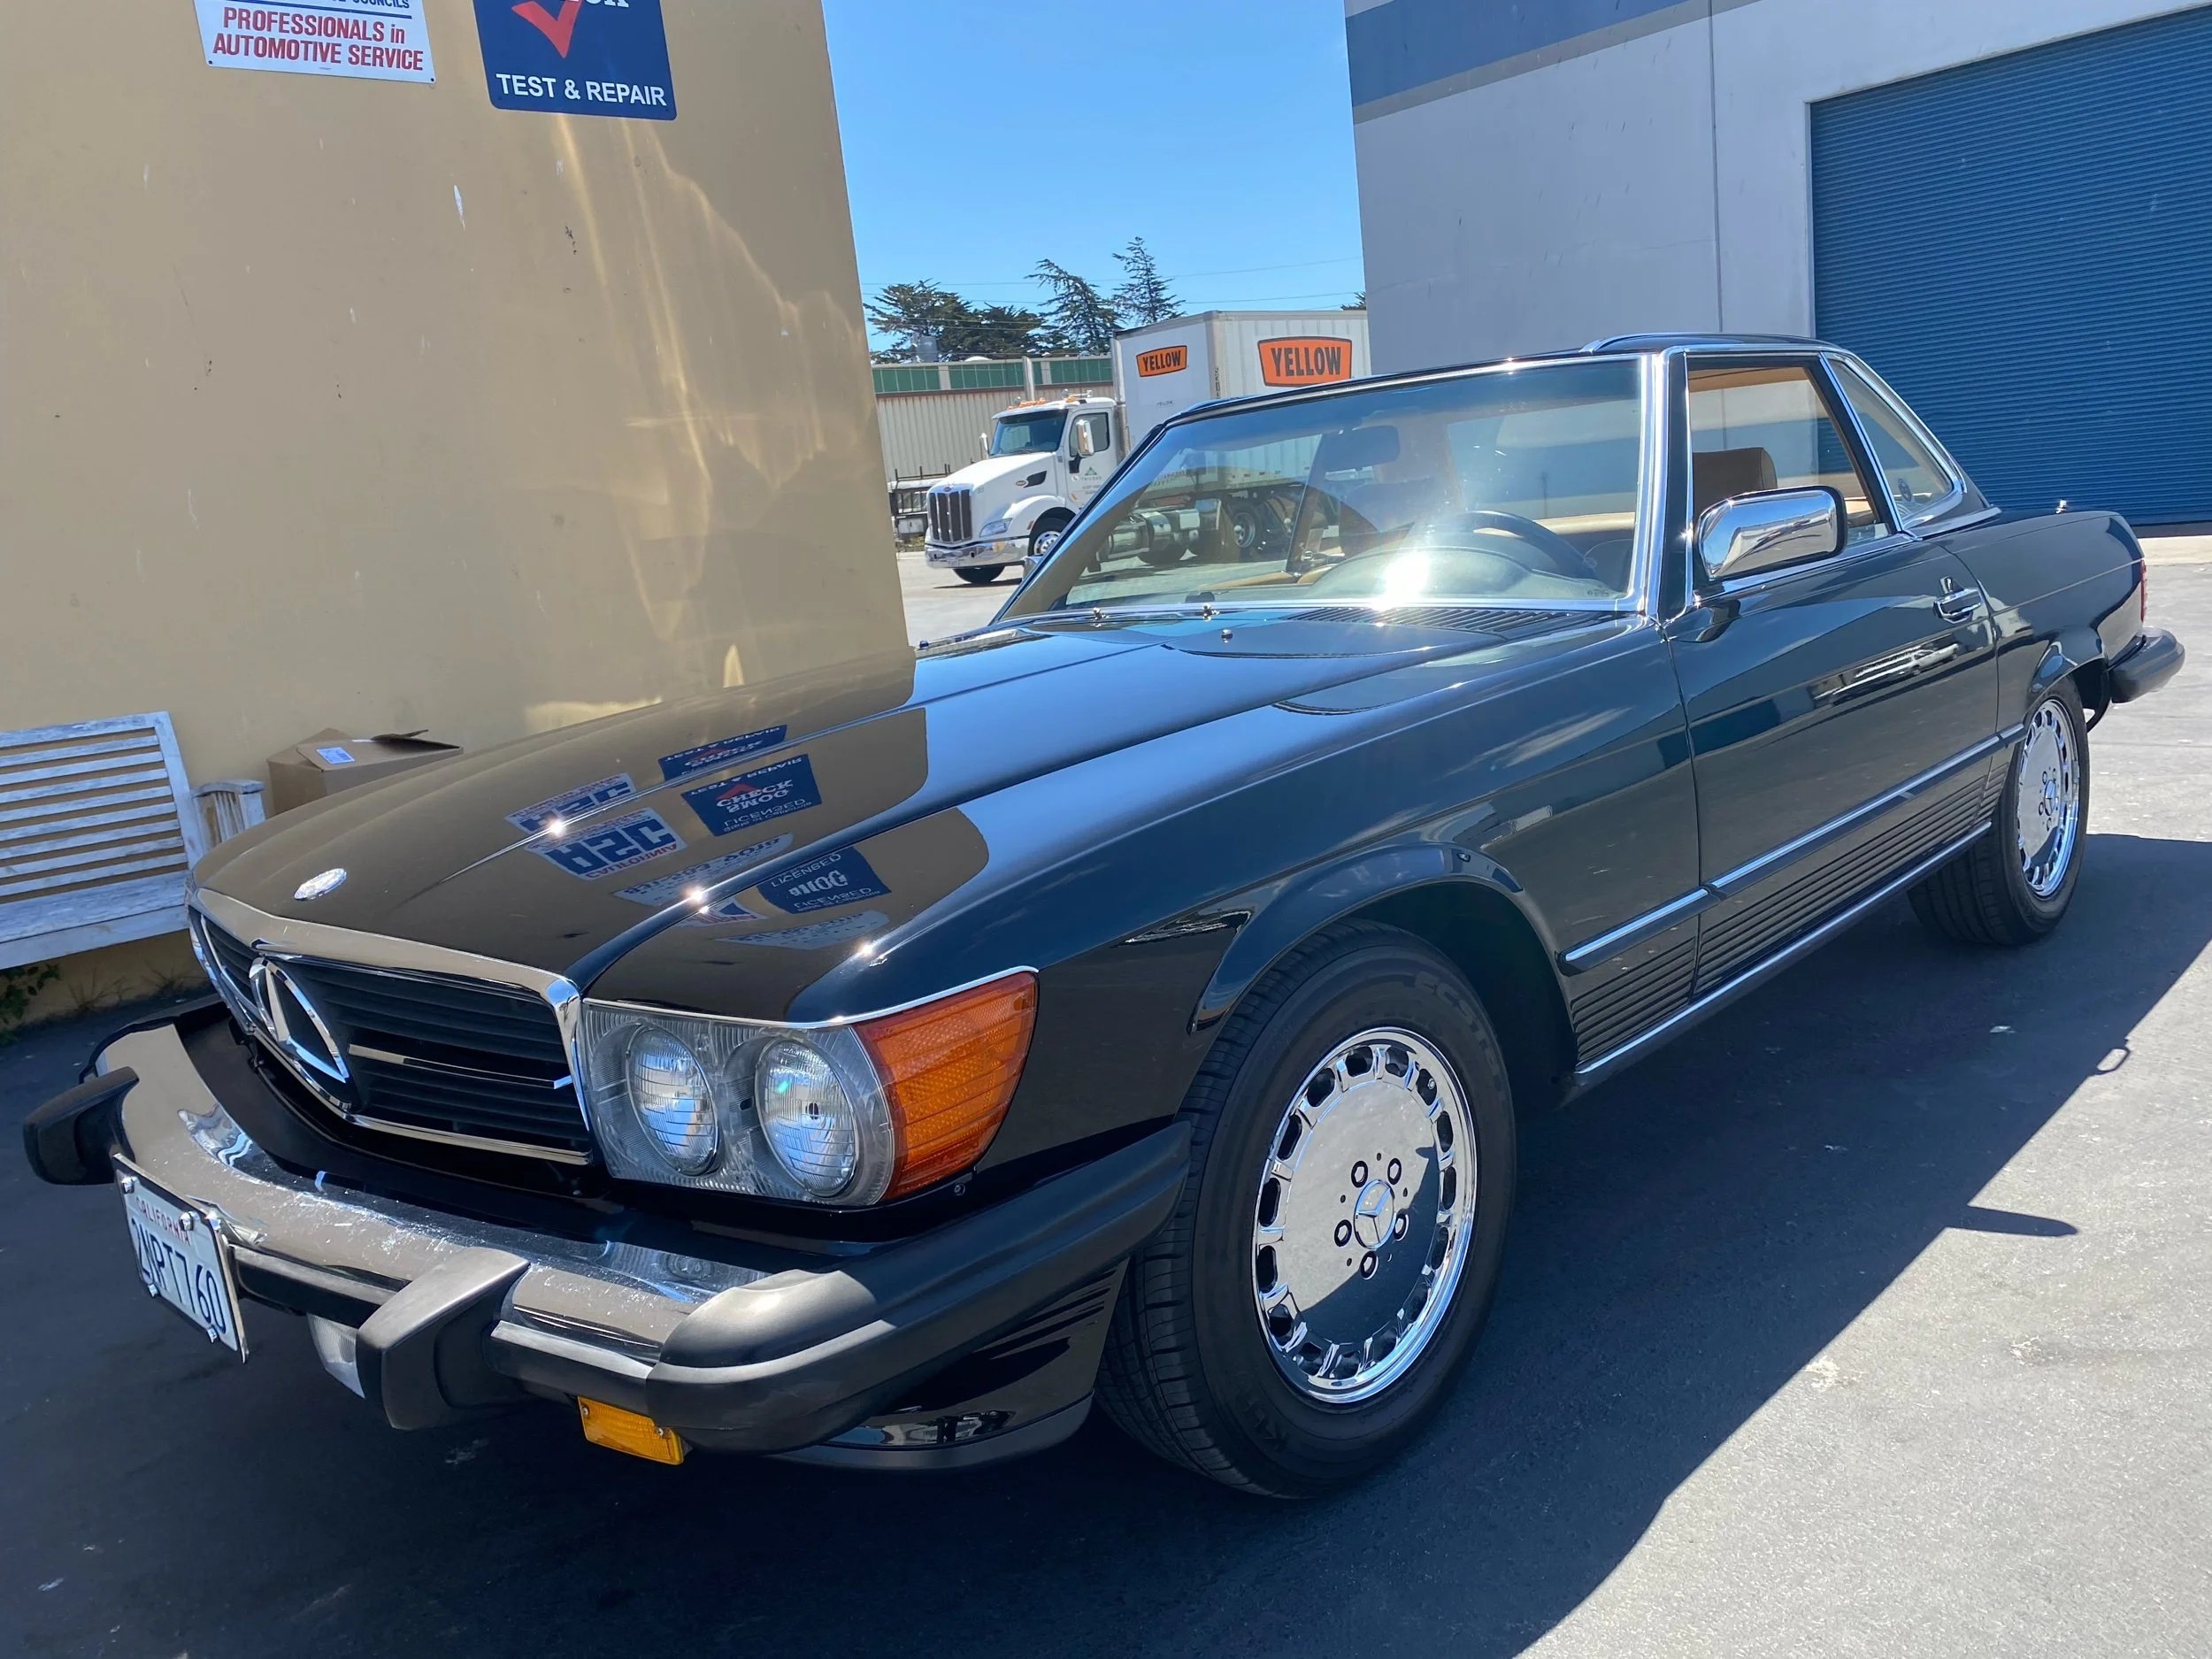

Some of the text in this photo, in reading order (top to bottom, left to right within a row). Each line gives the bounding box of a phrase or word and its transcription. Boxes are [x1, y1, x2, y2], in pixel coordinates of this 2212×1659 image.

[224, 7, 405, 43] PROFESSIONALS in
[212, 33, 423, 71] AUTOMOTIVE SERVICE
[495, 73, 666, 106] TEST & REPAIR
[1143, 350, 1181, 372] YELLOW
[1271, 346, 1340, 377] YELLOW
